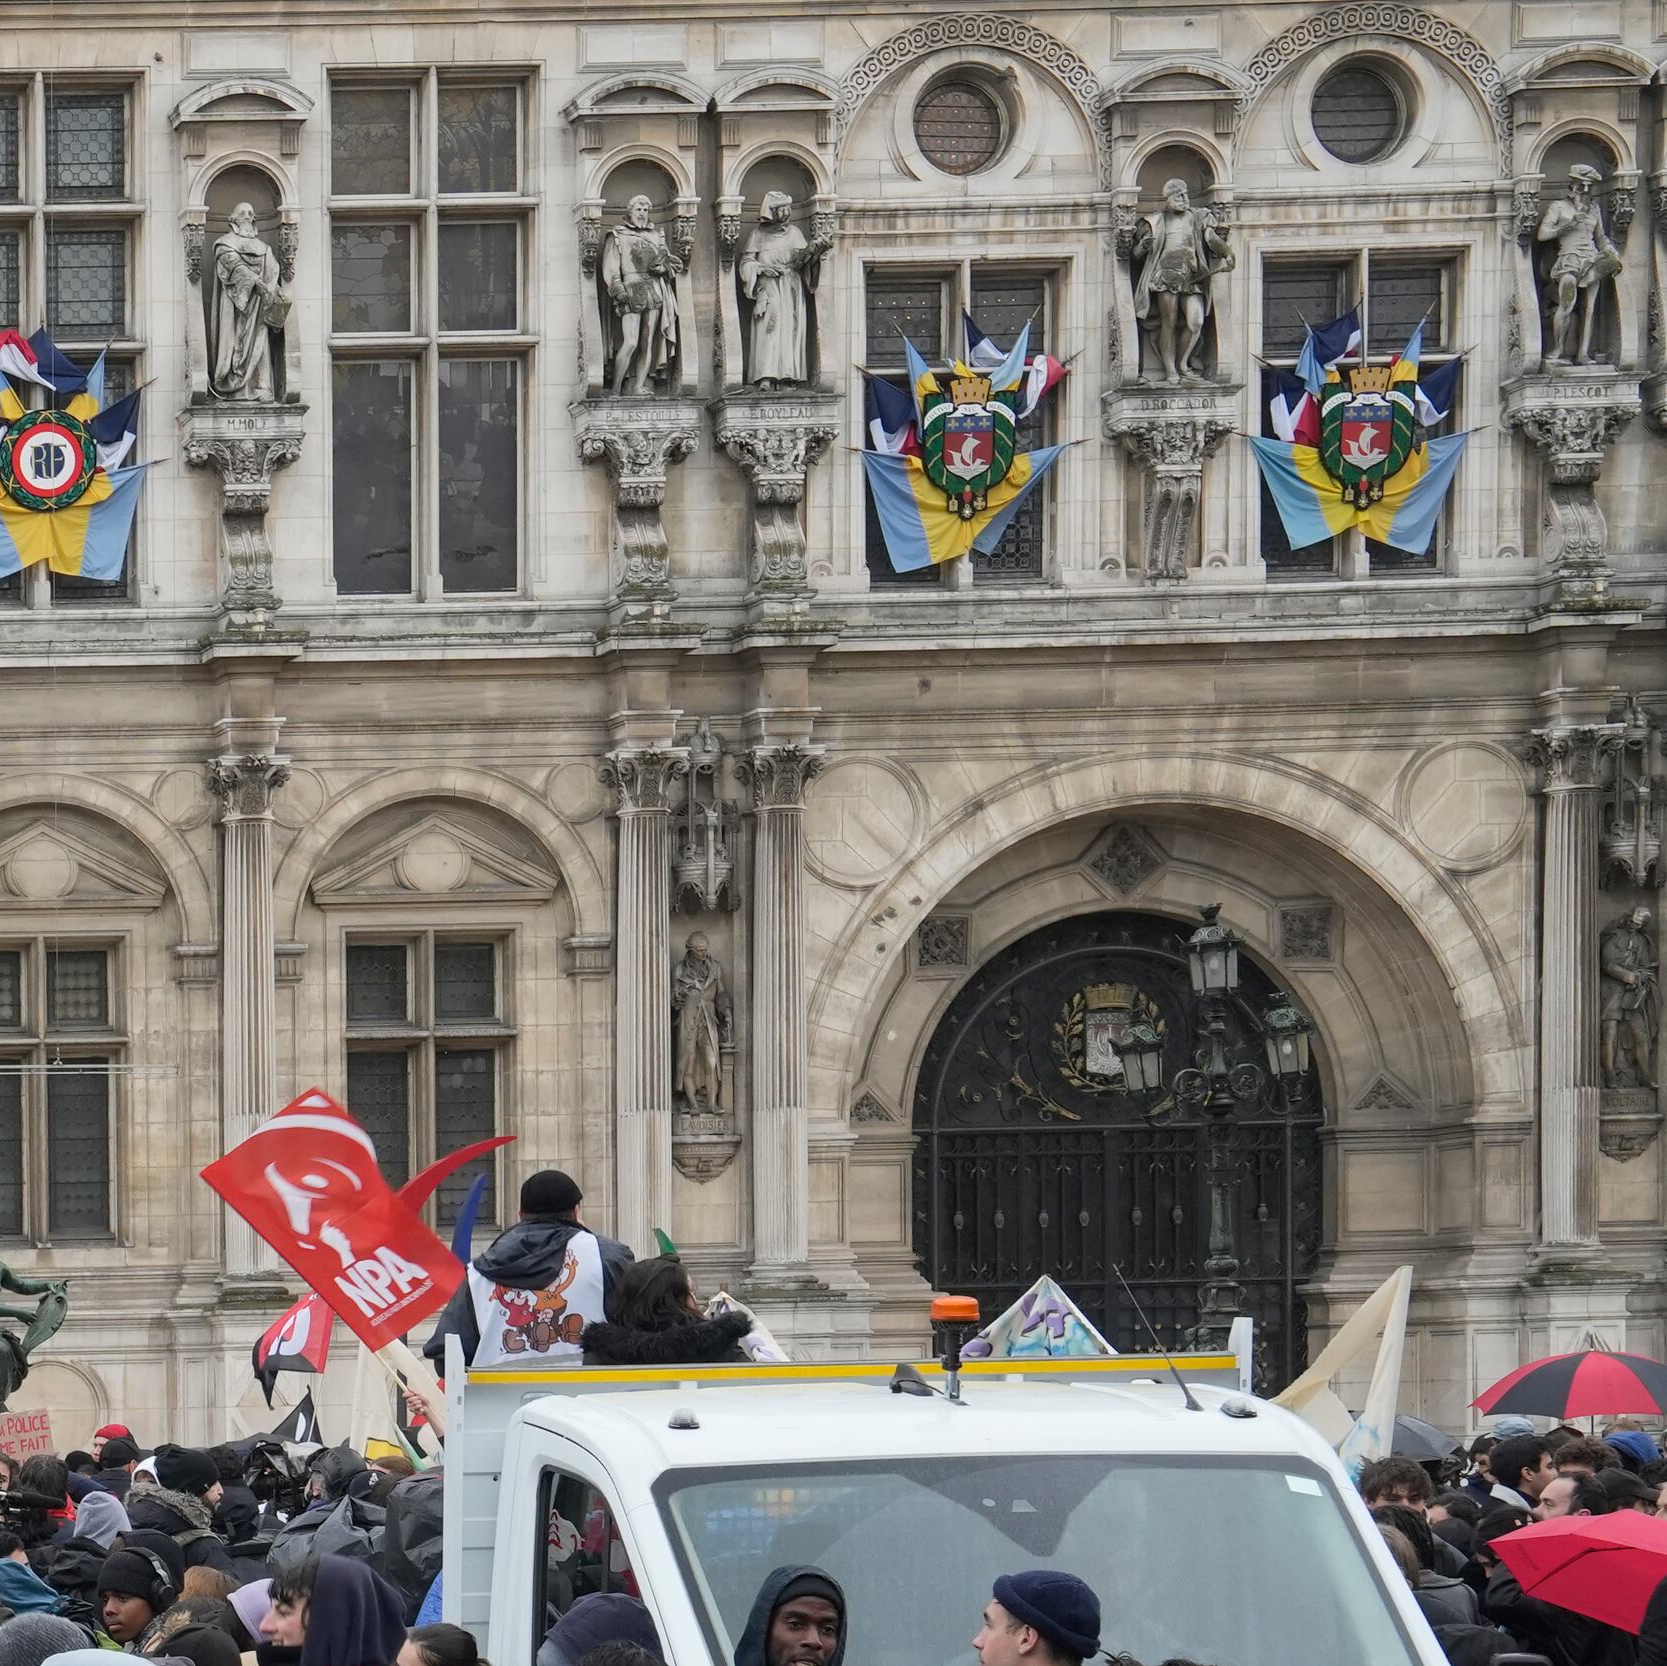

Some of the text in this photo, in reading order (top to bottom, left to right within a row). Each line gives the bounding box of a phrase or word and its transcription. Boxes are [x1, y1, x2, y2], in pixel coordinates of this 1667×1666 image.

[680, 1118, 730, 1131] LAVOISIER
[334, 1246, 429, 1318] NPA
[7, 1414, 50, 1435] POLICE
[0, 1434, 49, 1455] ME FAIT
